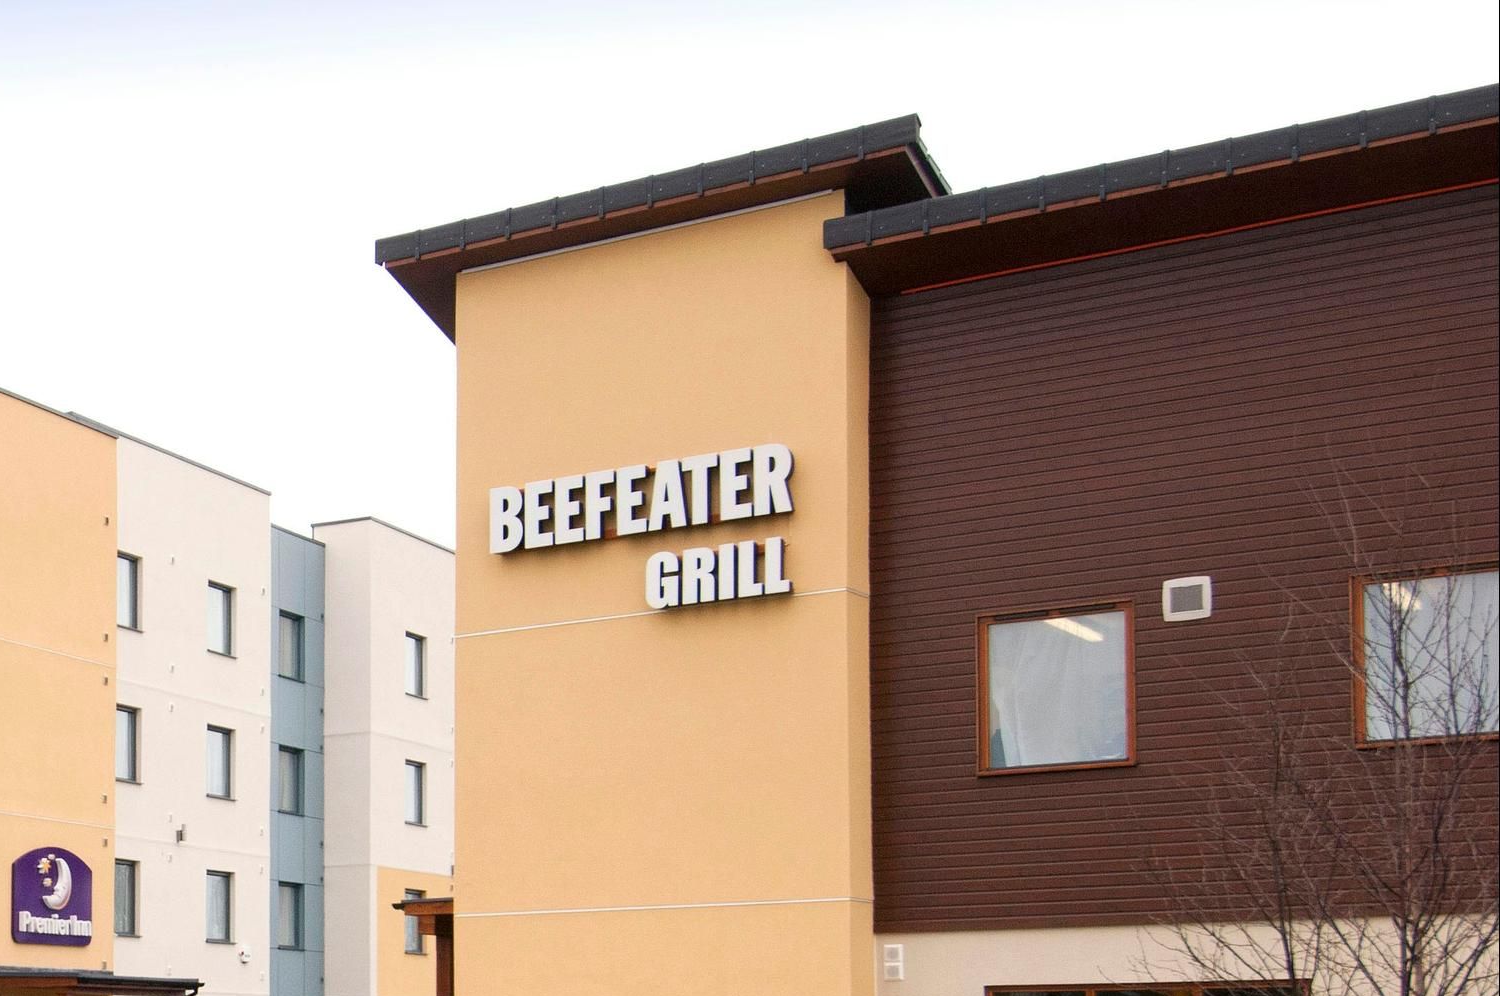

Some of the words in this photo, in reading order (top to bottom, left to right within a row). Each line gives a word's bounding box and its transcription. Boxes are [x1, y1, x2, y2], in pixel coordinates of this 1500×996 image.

[489, 443, 795, 554] BEEFEATER
[645, 536, 791, 609] GRILL
[18, 910, 70, 936] Premier
[69, 915, 92, 936] Inn
